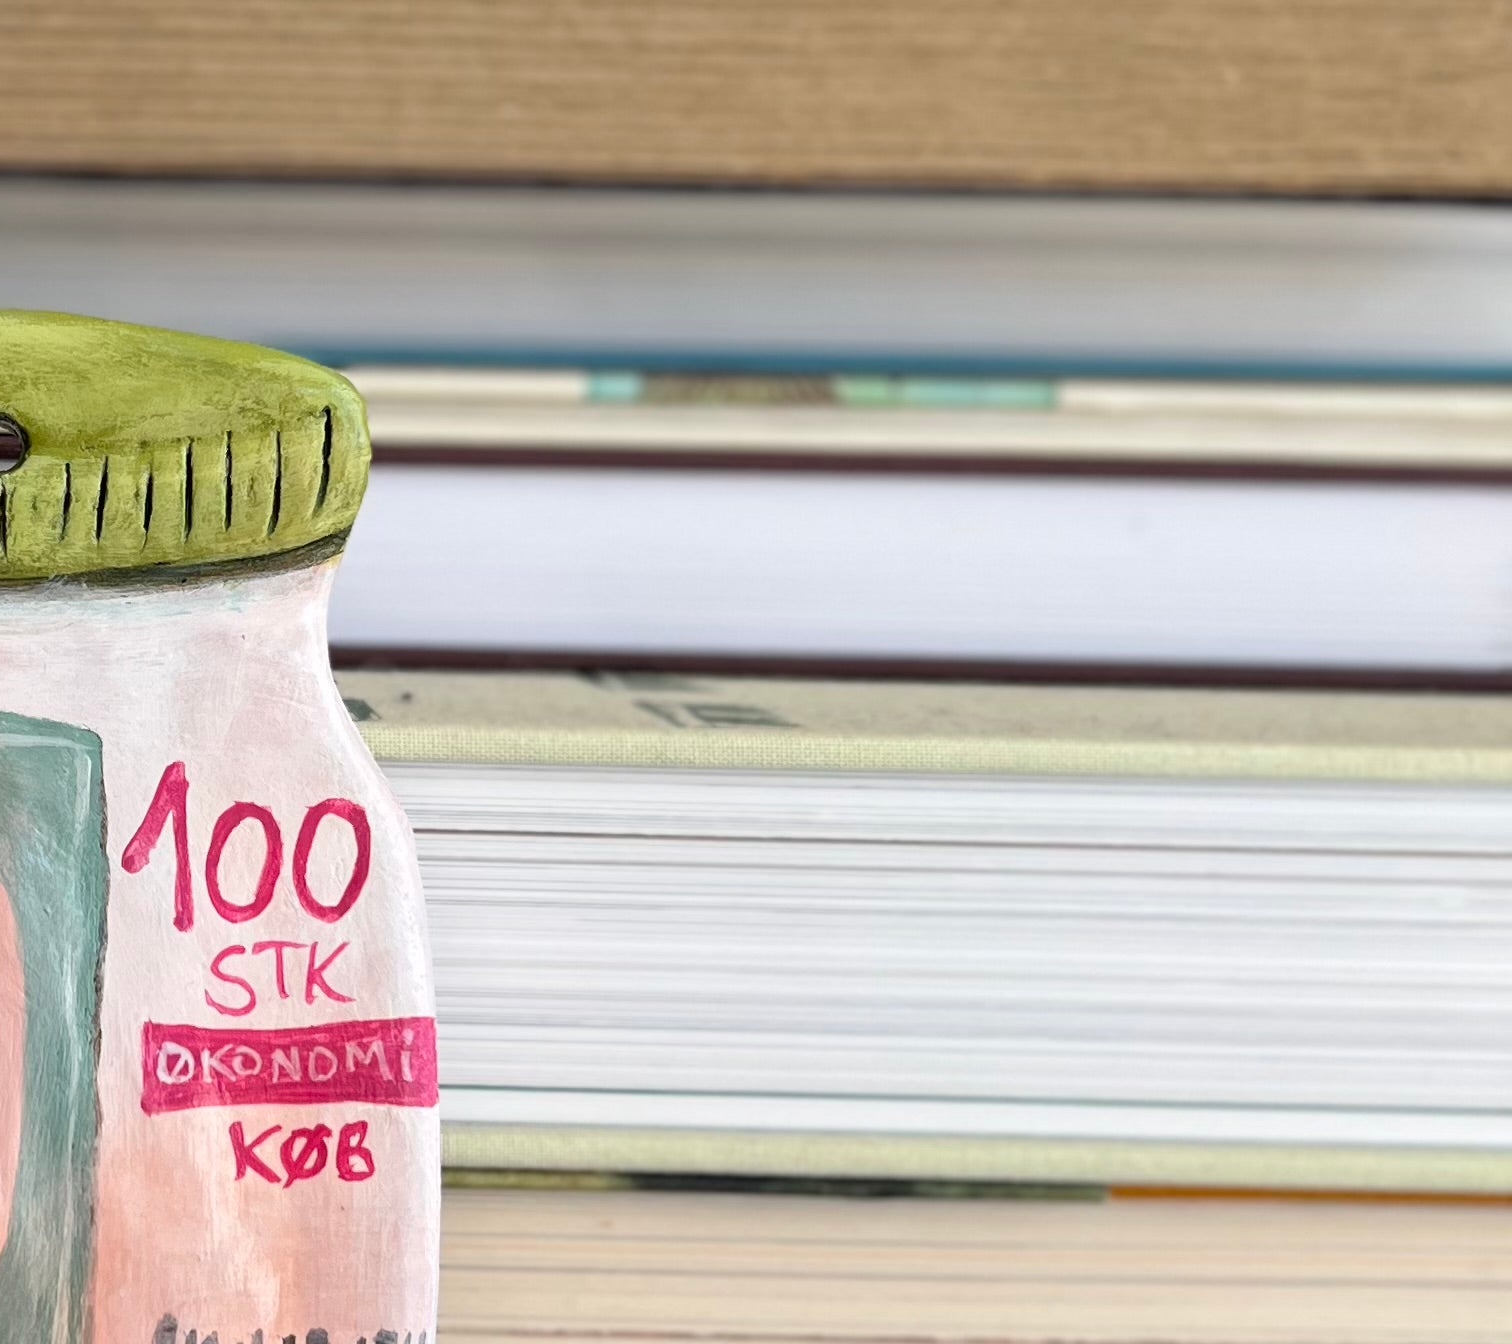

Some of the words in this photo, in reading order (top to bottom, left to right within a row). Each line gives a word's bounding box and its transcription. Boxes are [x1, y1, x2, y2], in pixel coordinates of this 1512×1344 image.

[122, 761, 371, 931] 100
[204, 941, 356, 1017] STK
[228, 1120, 376, 1189] KØB
